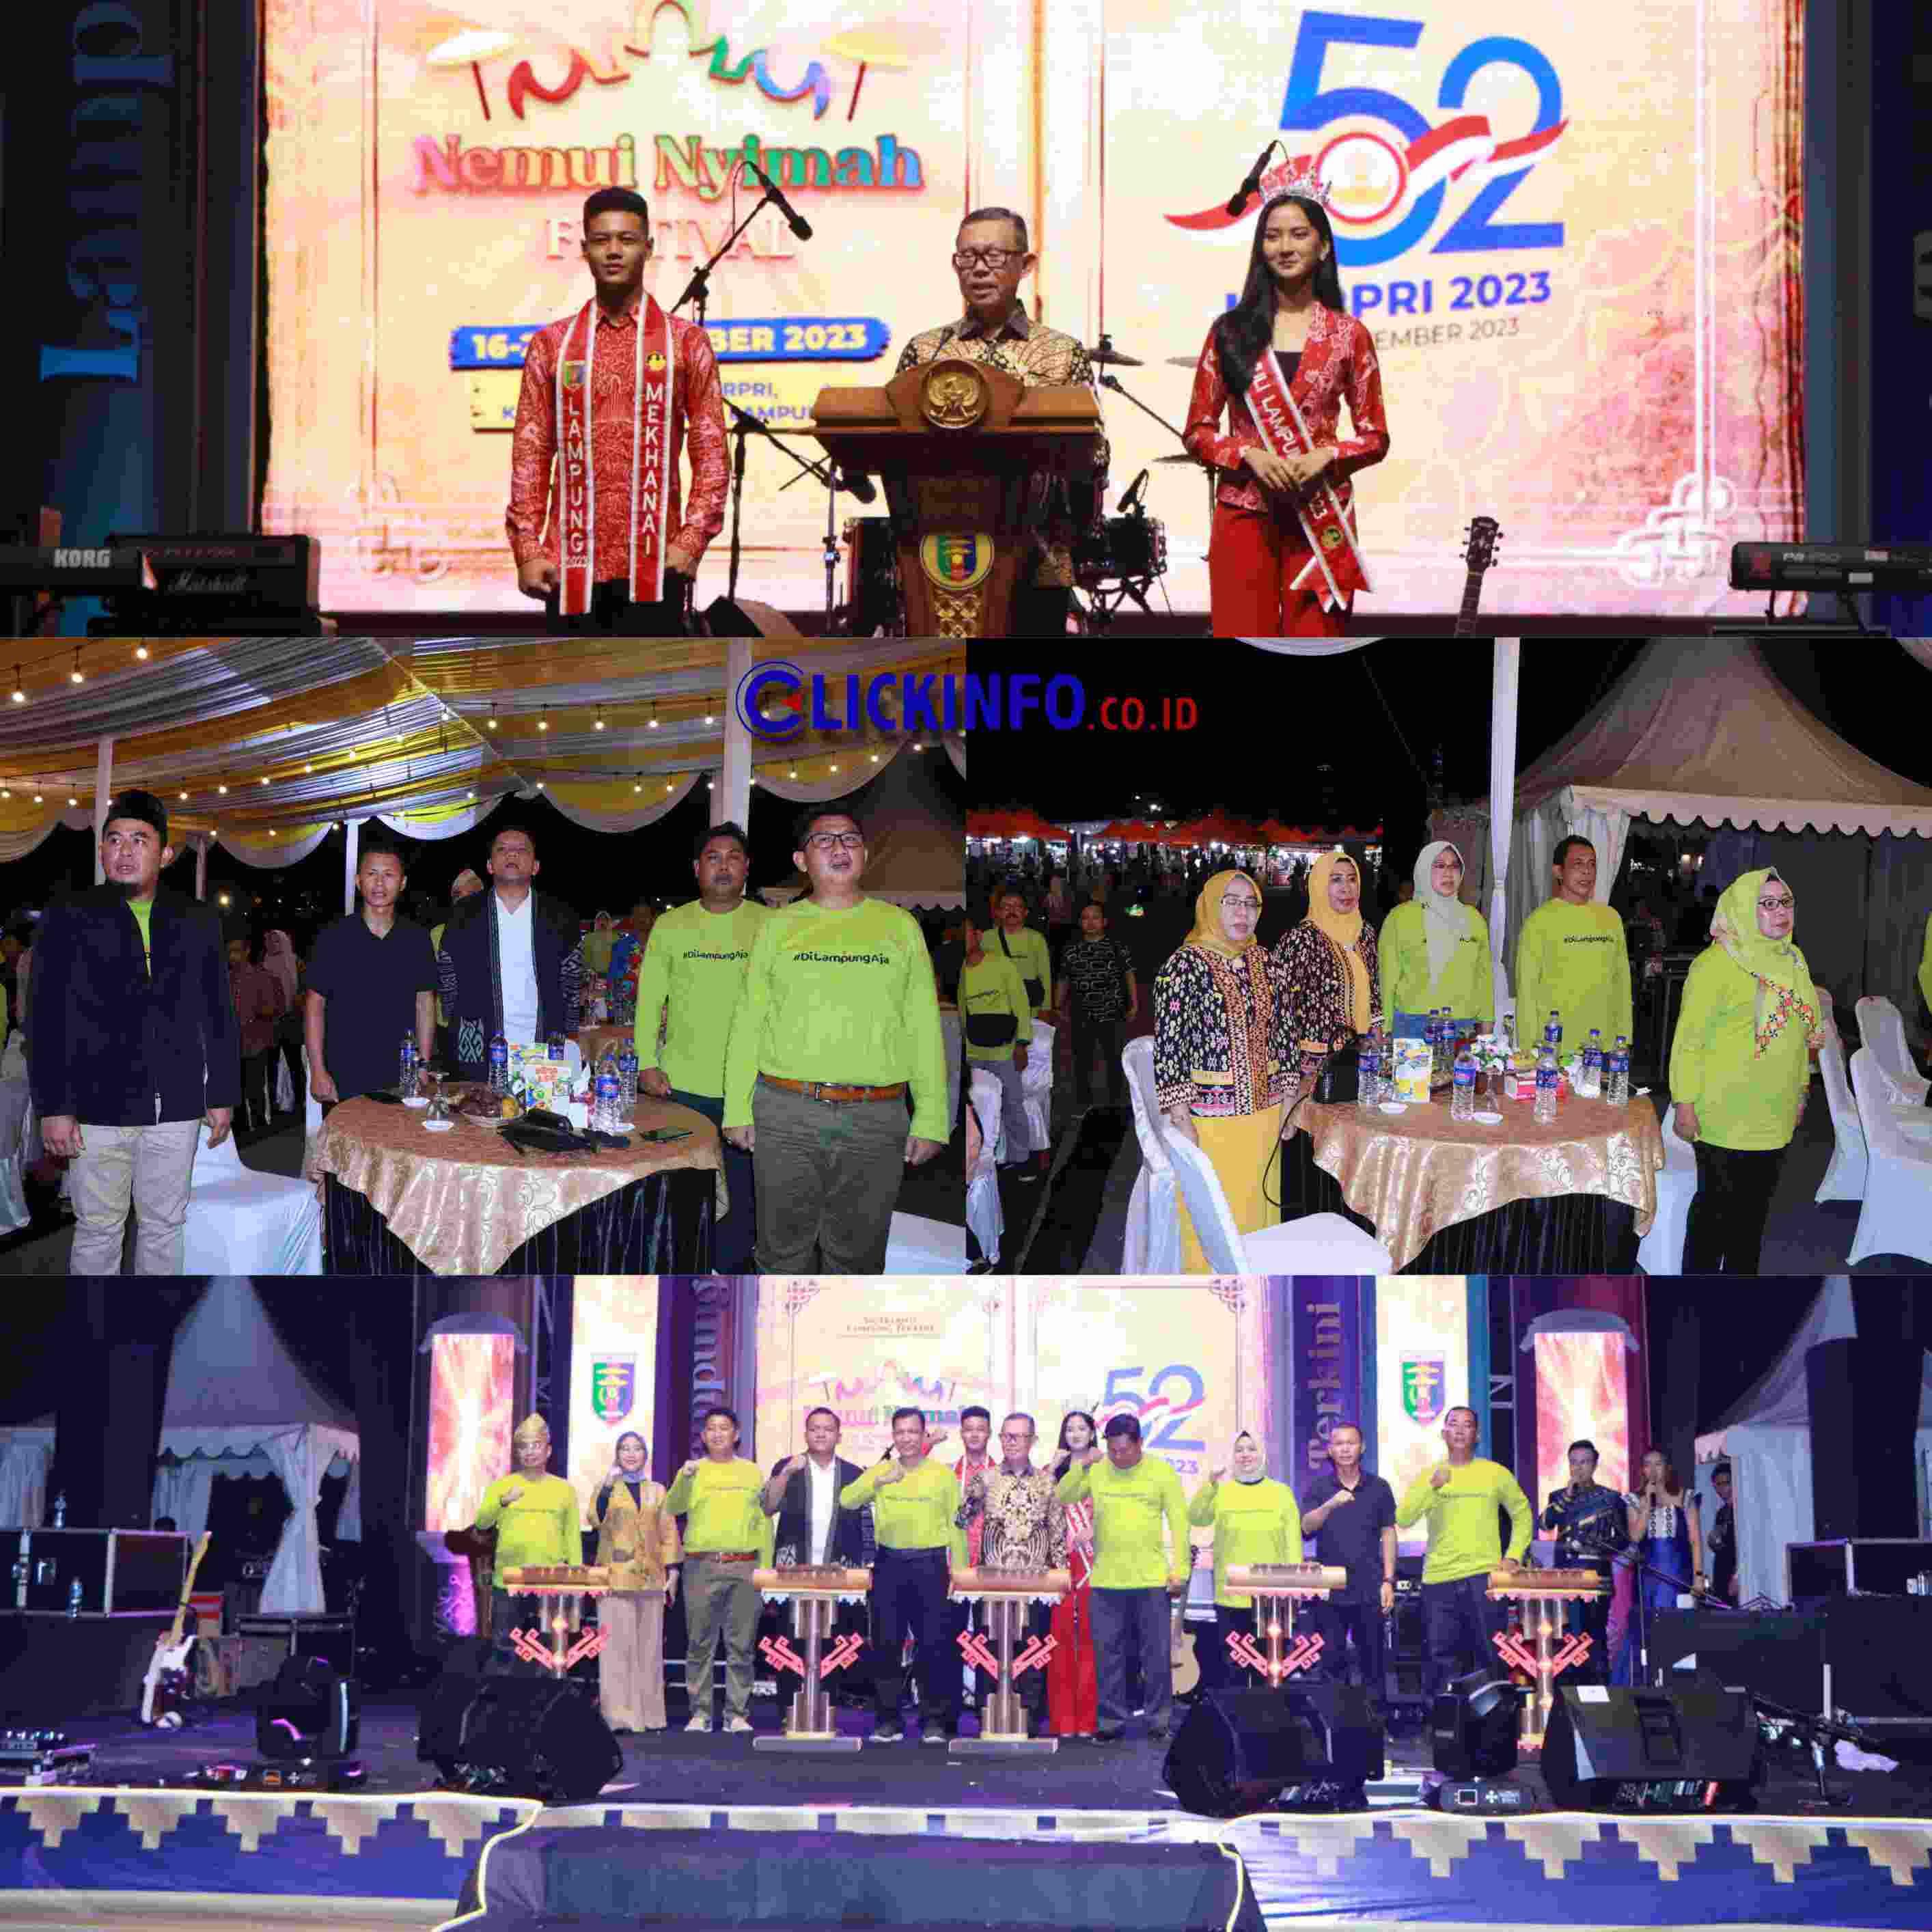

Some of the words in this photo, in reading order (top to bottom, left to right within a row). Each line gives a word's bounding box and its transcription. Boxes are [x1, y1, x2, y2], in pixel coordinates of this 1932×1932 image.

[1280, 10, 1564, 266] 52
[38, 0, 174, 383] Lamp
[411, 135, 638, 194] Nemui
[654, 135, 926, 201] Nyimah
[547, 218, 795, 260] FTIVAL
[1449, 271, 1551, 311] 2023
[784, 325, 866, 350] 2023
[1375, 323, 1463, 351] EMBER
[1469, 318, 1520, 341] 2023
[721, 382, 778, 398] RPRI,
[1261, 394, 1302, 454] LAMPU
[566, 395, 586, 554] LAMPUNG
[641, 381, 664, 557] MEKHANAI
[53, 549, 111, 568] KORG
[792, 951, 890, 965] #DiLampungAja
[1103, 1364, 1206, 1453] 52
